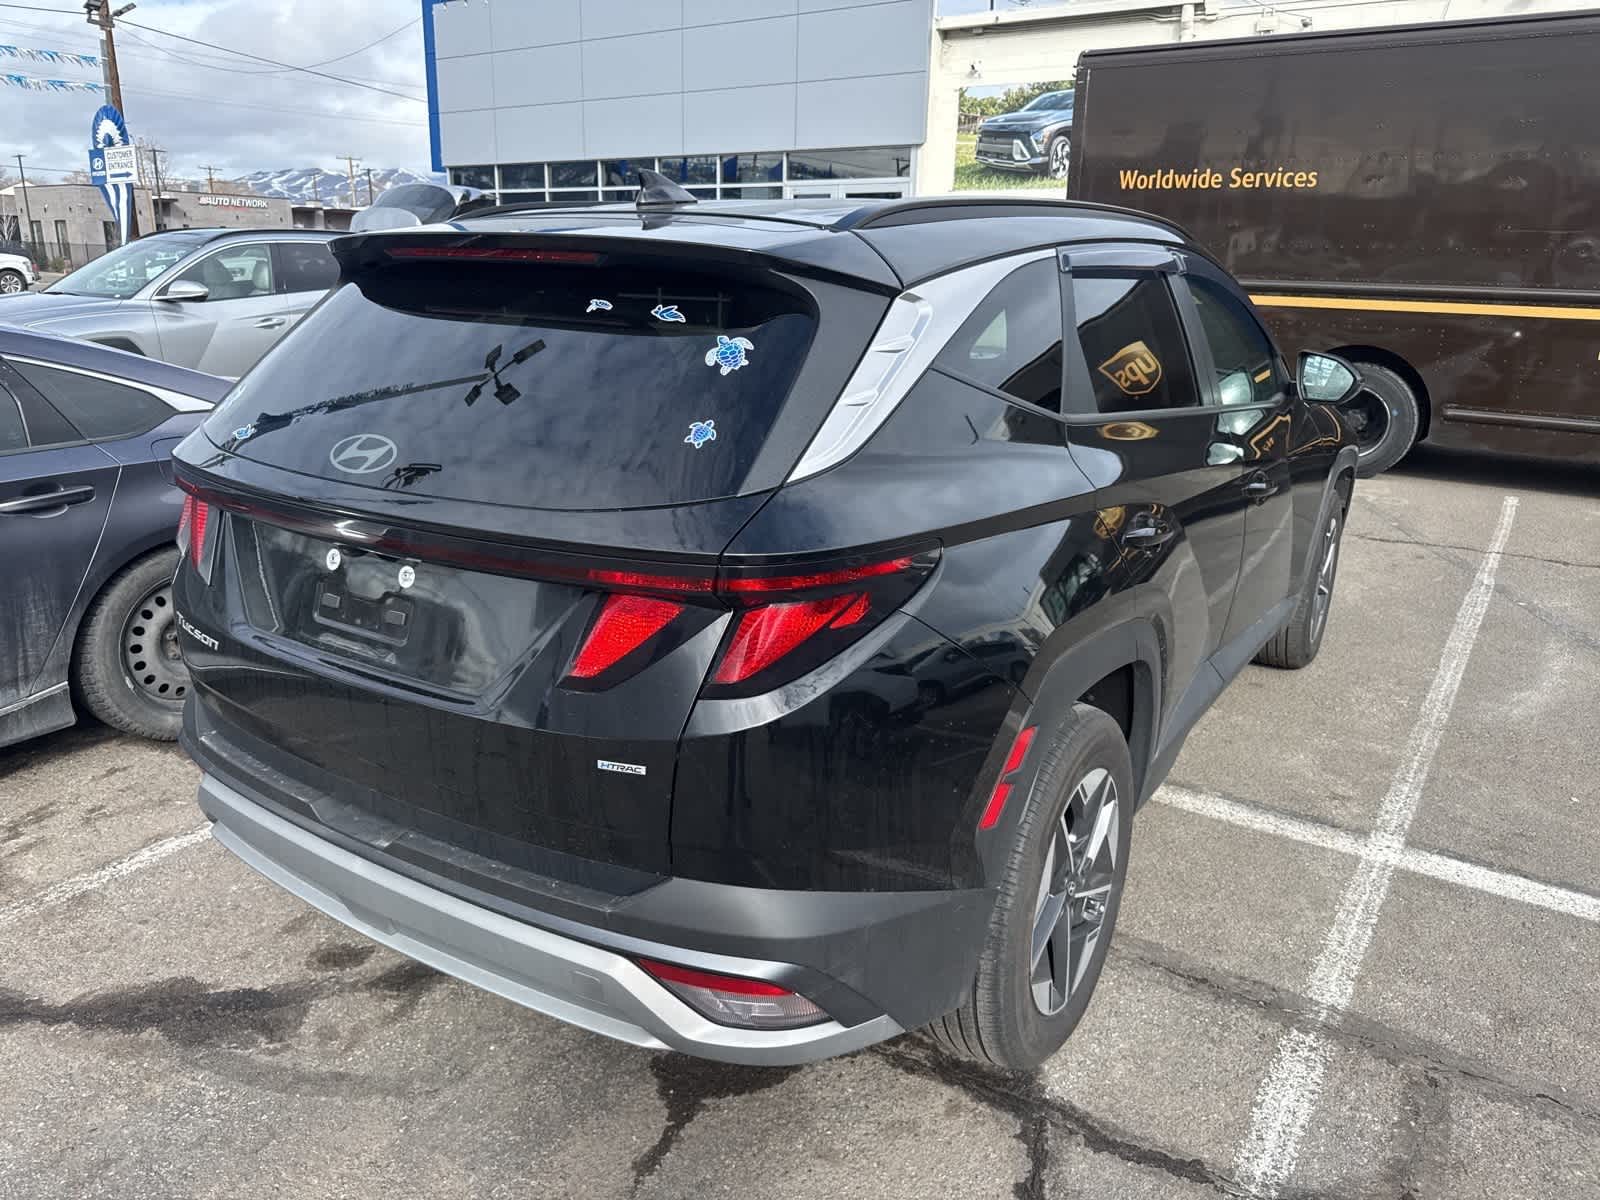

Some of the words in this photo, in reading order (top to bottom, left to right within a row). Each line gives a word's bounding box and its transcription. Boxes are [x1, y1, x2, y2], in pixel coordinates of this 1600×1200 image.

[106, 150, 133, 160] CUSTOMER
[108, 160, 134, 170] ENTRANCE
[1119, 168, 1223, 190] Worldwide
[1229, 167, 1318, 189] Services
[207, 196, 229, 206] AUTO
[231, 198, 268, 208] NETWORK
[599, 761, 644, 775] HTRAC
